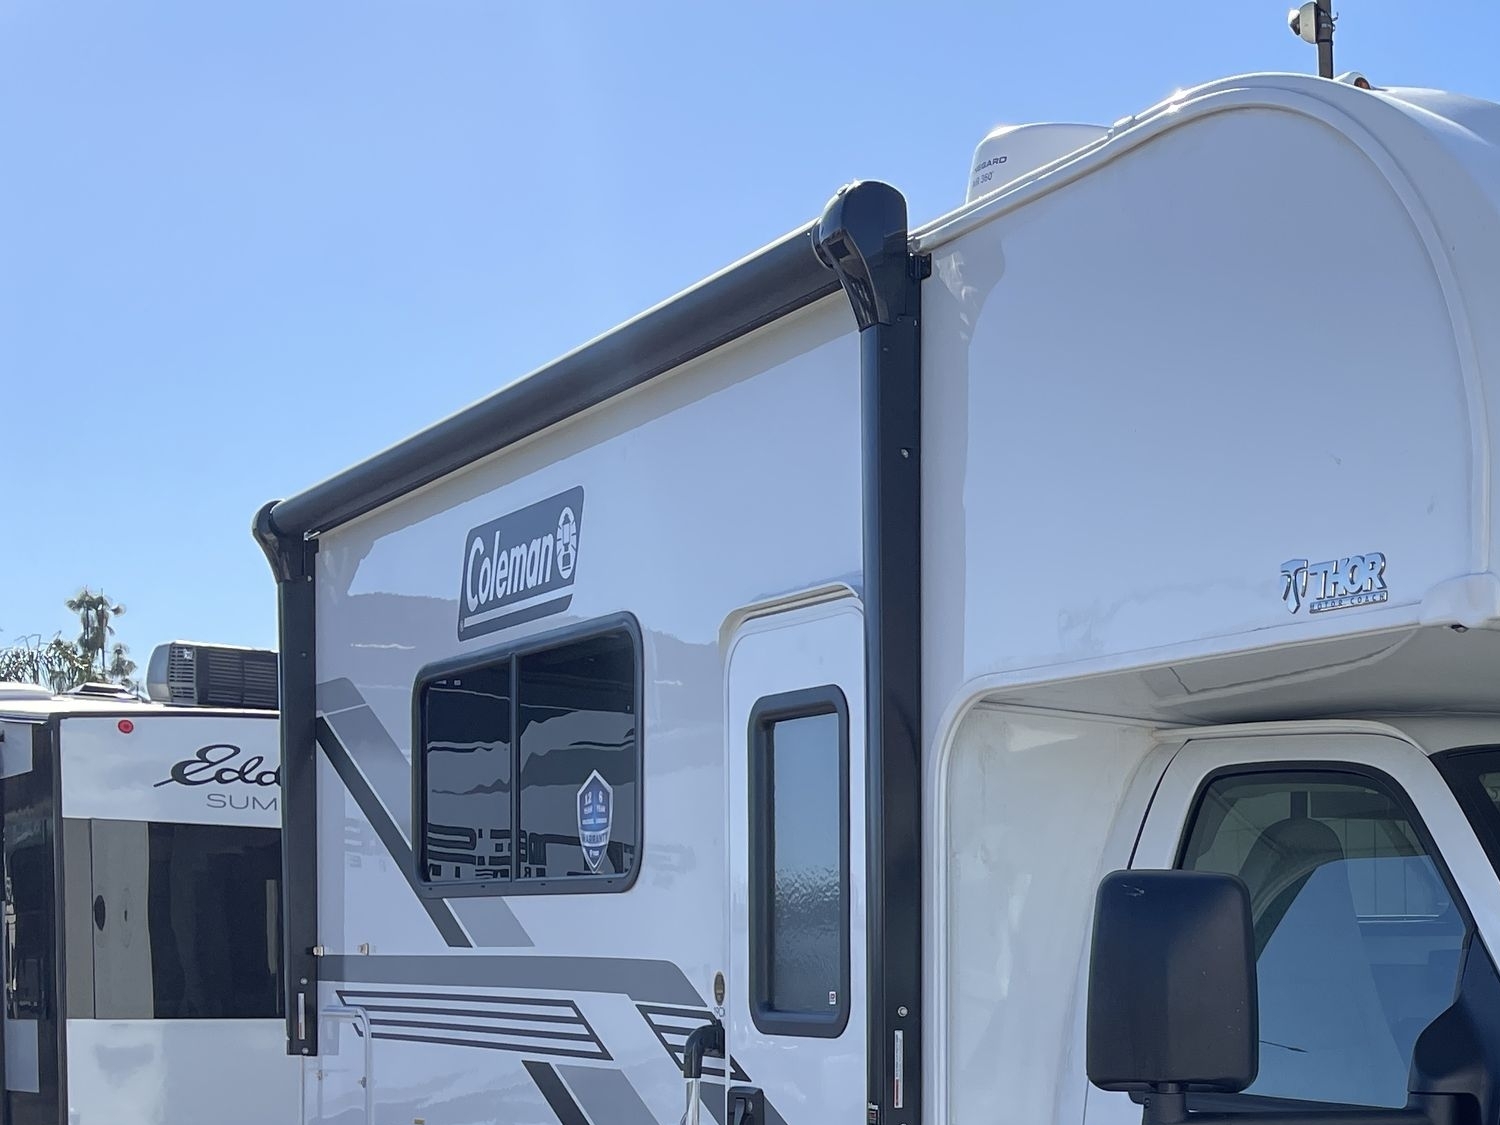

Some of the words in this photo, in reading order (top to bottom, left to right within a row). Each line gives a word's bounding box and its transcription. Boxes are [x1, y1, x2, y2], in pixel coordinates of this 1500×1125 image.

[465, 530, 554, 613] Coleman
[1309, 552, 1387, 600] THOR
[1310, 600, 1343, 611] MOTOR
[1350, 593, 1386, 606] COACH
